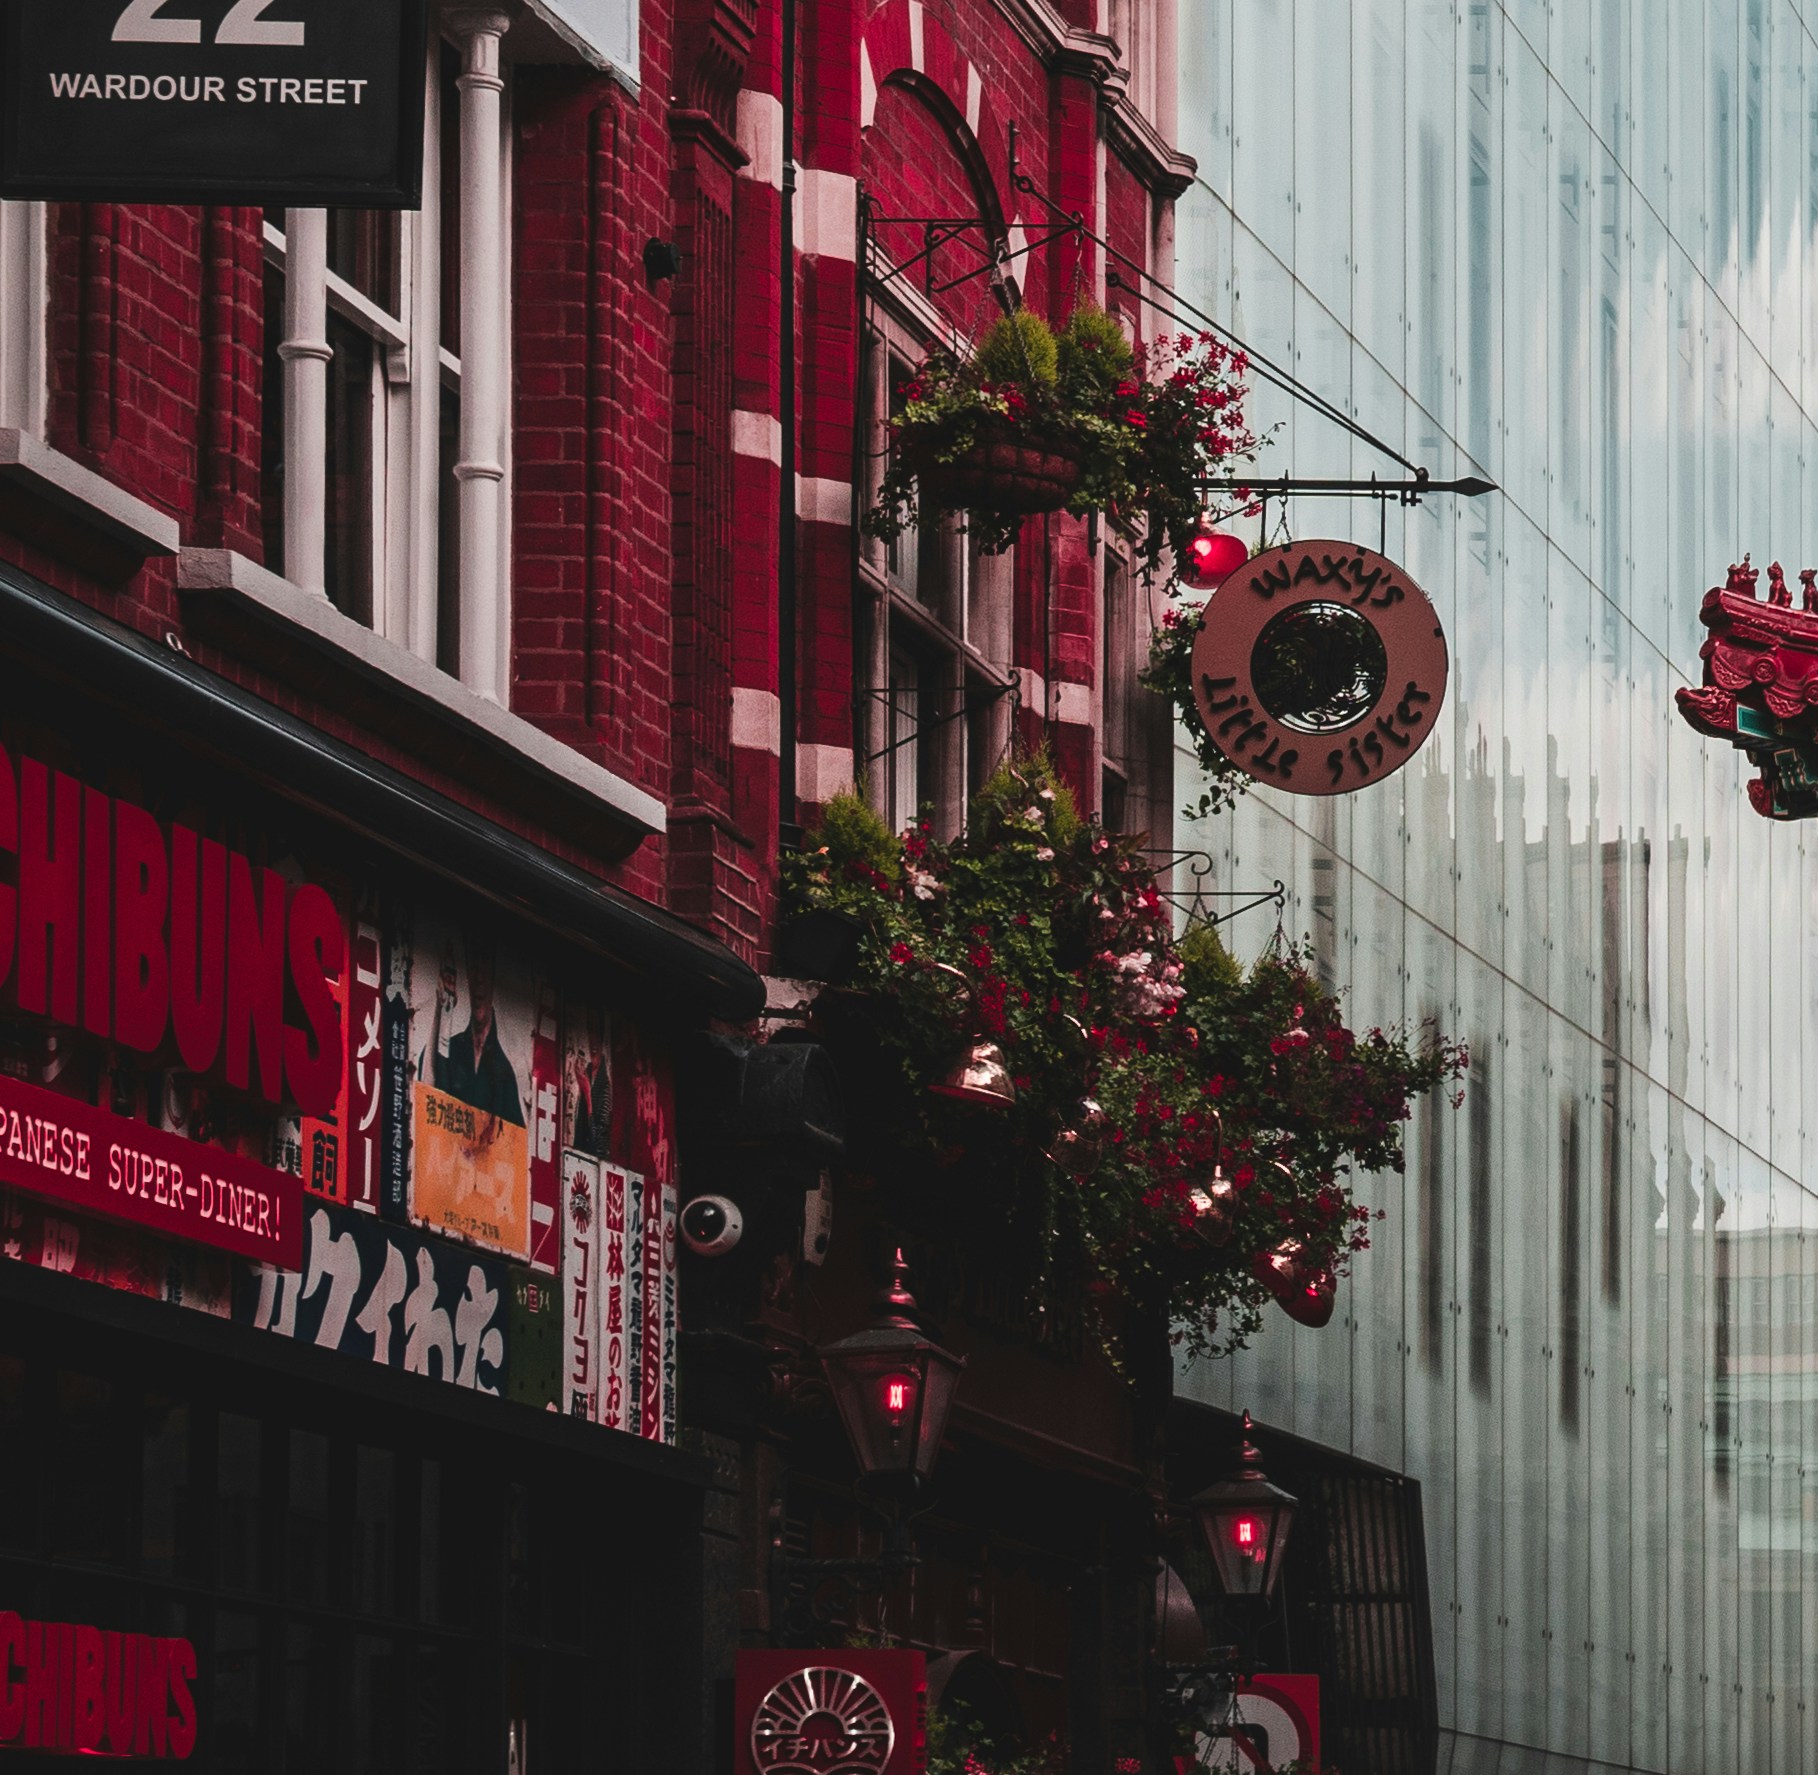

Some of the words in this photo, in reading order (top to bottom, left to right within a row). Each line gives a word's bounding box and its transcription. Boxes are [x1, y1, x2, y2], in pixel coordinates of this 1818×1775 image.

[50, 73, 225, 102] WARDOUR
[237, 77, 368, 105] STREET
[108, 1143, 282, 1241] SUPER-DINER!
[0, 1610, 198, 1761] CHIBUNS
